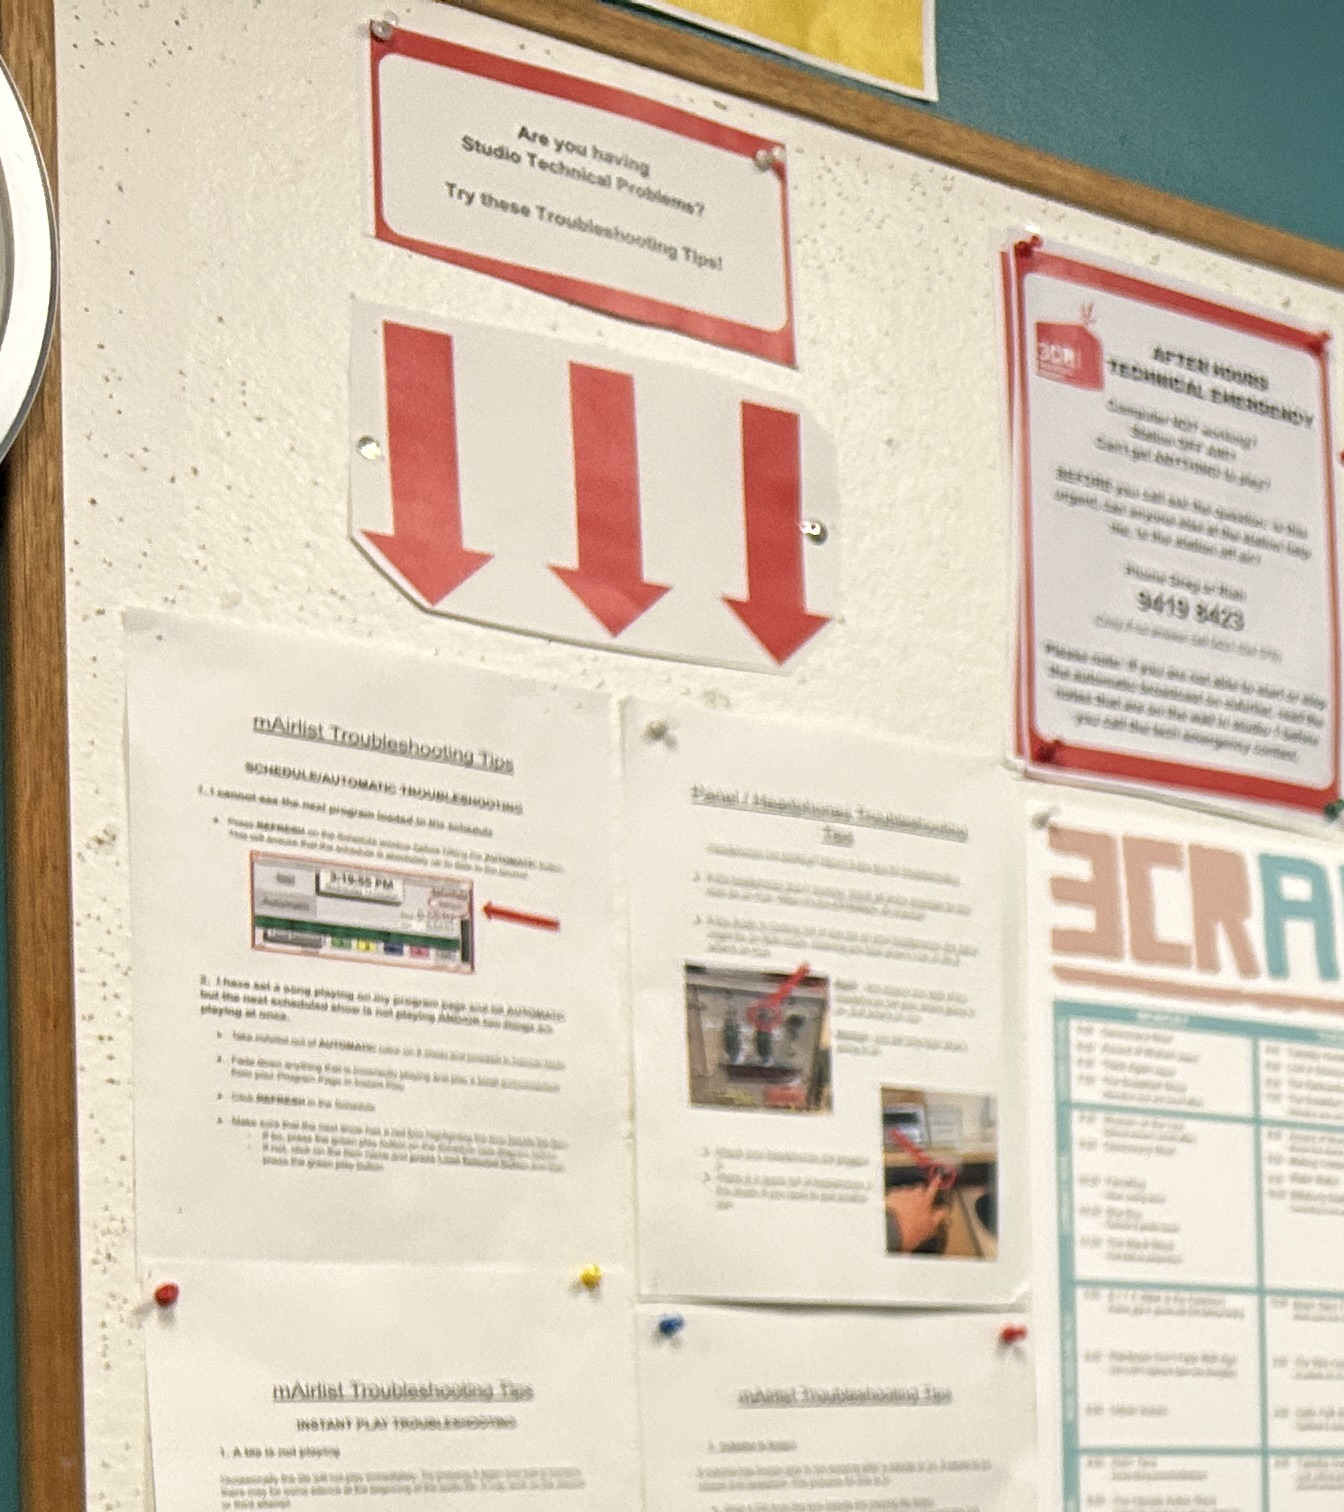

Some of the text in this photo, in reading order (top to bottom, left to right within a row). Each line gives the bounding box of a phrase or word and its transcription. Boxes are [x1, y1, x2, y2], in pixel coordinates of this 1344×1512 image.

[460, 134, 706, 218] Studio Technical Problems?
[518, 125, 650, 178] Are you having
[444, 181, 724, 272] Try these Troubleshooting Tips!
[1107, 357, 1314, 430] TECHNICAL EMERGENCY
[1153, 343, 1270, 392] AFTER HOURS
[1136, 589, 1246, 633] 9419 8423
[252, 715, 515, 774] mAirlist Troubleshooting Tips
[244, 760, 524, 816] SCHEDULE/AUTOMATIC TROUBLESHOOTING
[1048, 820, 1261, 980] 3CR
[272, 1379, 535, 1402] mAirlist Troubleshooting Tips
[296, 1415, 352, 1432] INSTANT
[355, 1417, 389, 1432] PLAY
